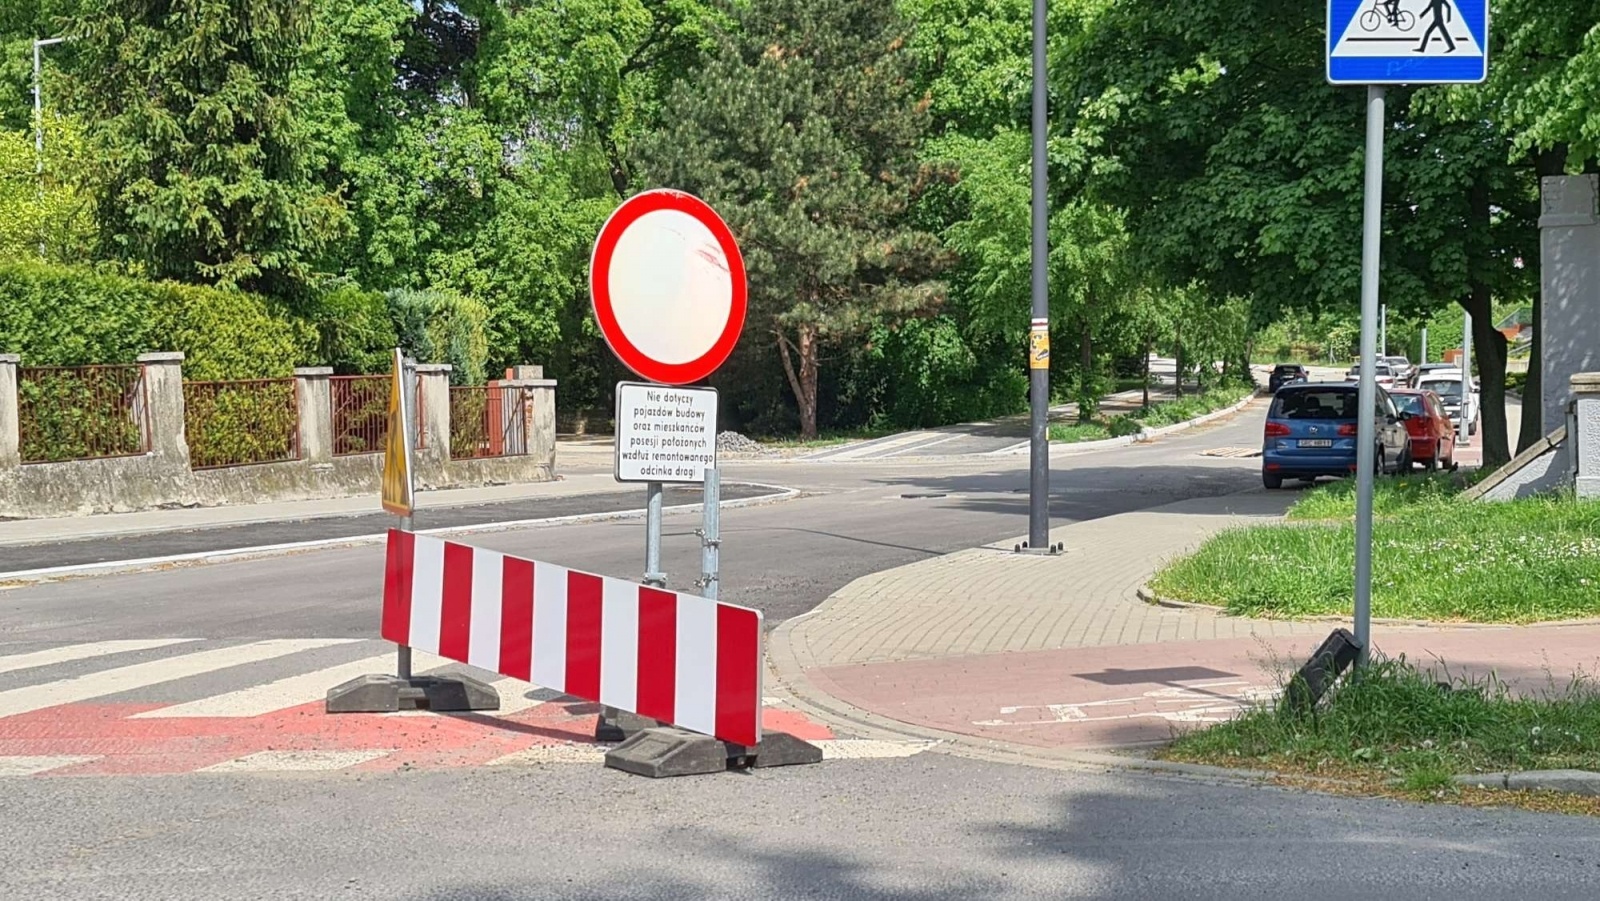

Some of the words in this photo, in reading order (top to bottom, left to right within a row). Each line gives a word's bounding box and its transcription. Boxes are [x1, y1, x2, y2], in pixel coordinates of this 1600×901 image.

[647, 391, 661, 402] Nie
[664, 392, 694, 405] dotyczy
[634, 405, 673, 418] pojazdów
[676, 409, 705, 421] budowy
[633, 422, 651, 431] oraz
[654, 421, 705, 433] mieszkańców
[630, 435, 659, 448] posesji
[662, 436, 707, 449] położonych
[622, 450, 649, 460] wzdłuż
[652, 452, 713, 464] remontowanego
[640, 464, 673, 476] odcinka
[675, 465, 696, 478] drogi
